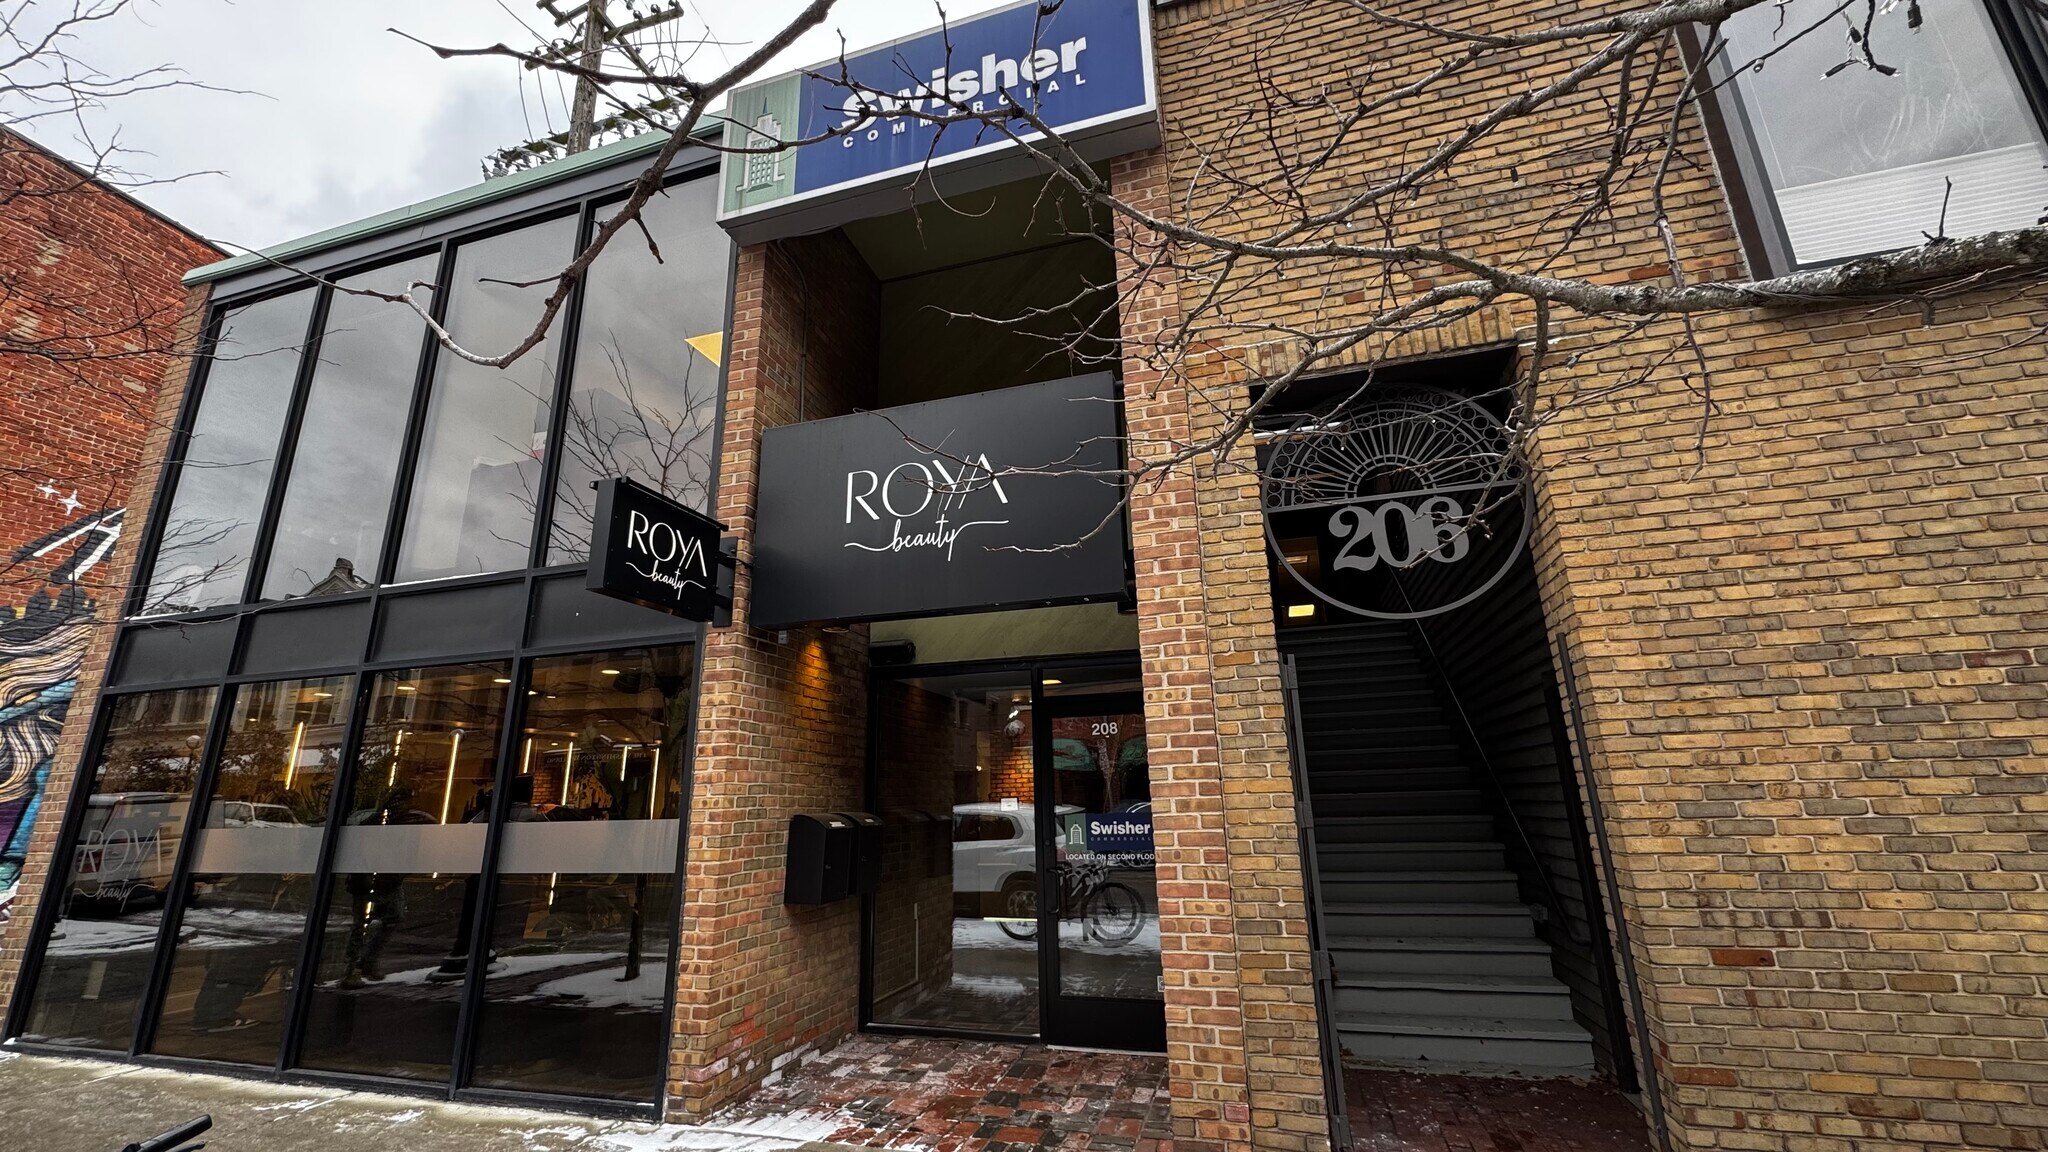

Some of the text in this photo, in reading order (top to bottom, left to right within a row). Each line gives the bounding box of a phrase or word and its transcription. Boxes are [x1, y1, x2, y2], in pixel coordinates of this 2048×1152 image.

[842, 37, 1087, 132] Swisher
[845, 453, 1009, 524] ROYA
[627, 510, 708, 578] ROYA
[1328, 495, 1470, 572] 206
[1091, 722, 1119, 736] 208
[79, 828, 162, 873] ROYA
[1090, 821, 1151, 835] Swisher
[1065, 853, 1095, 861] LOCATED
